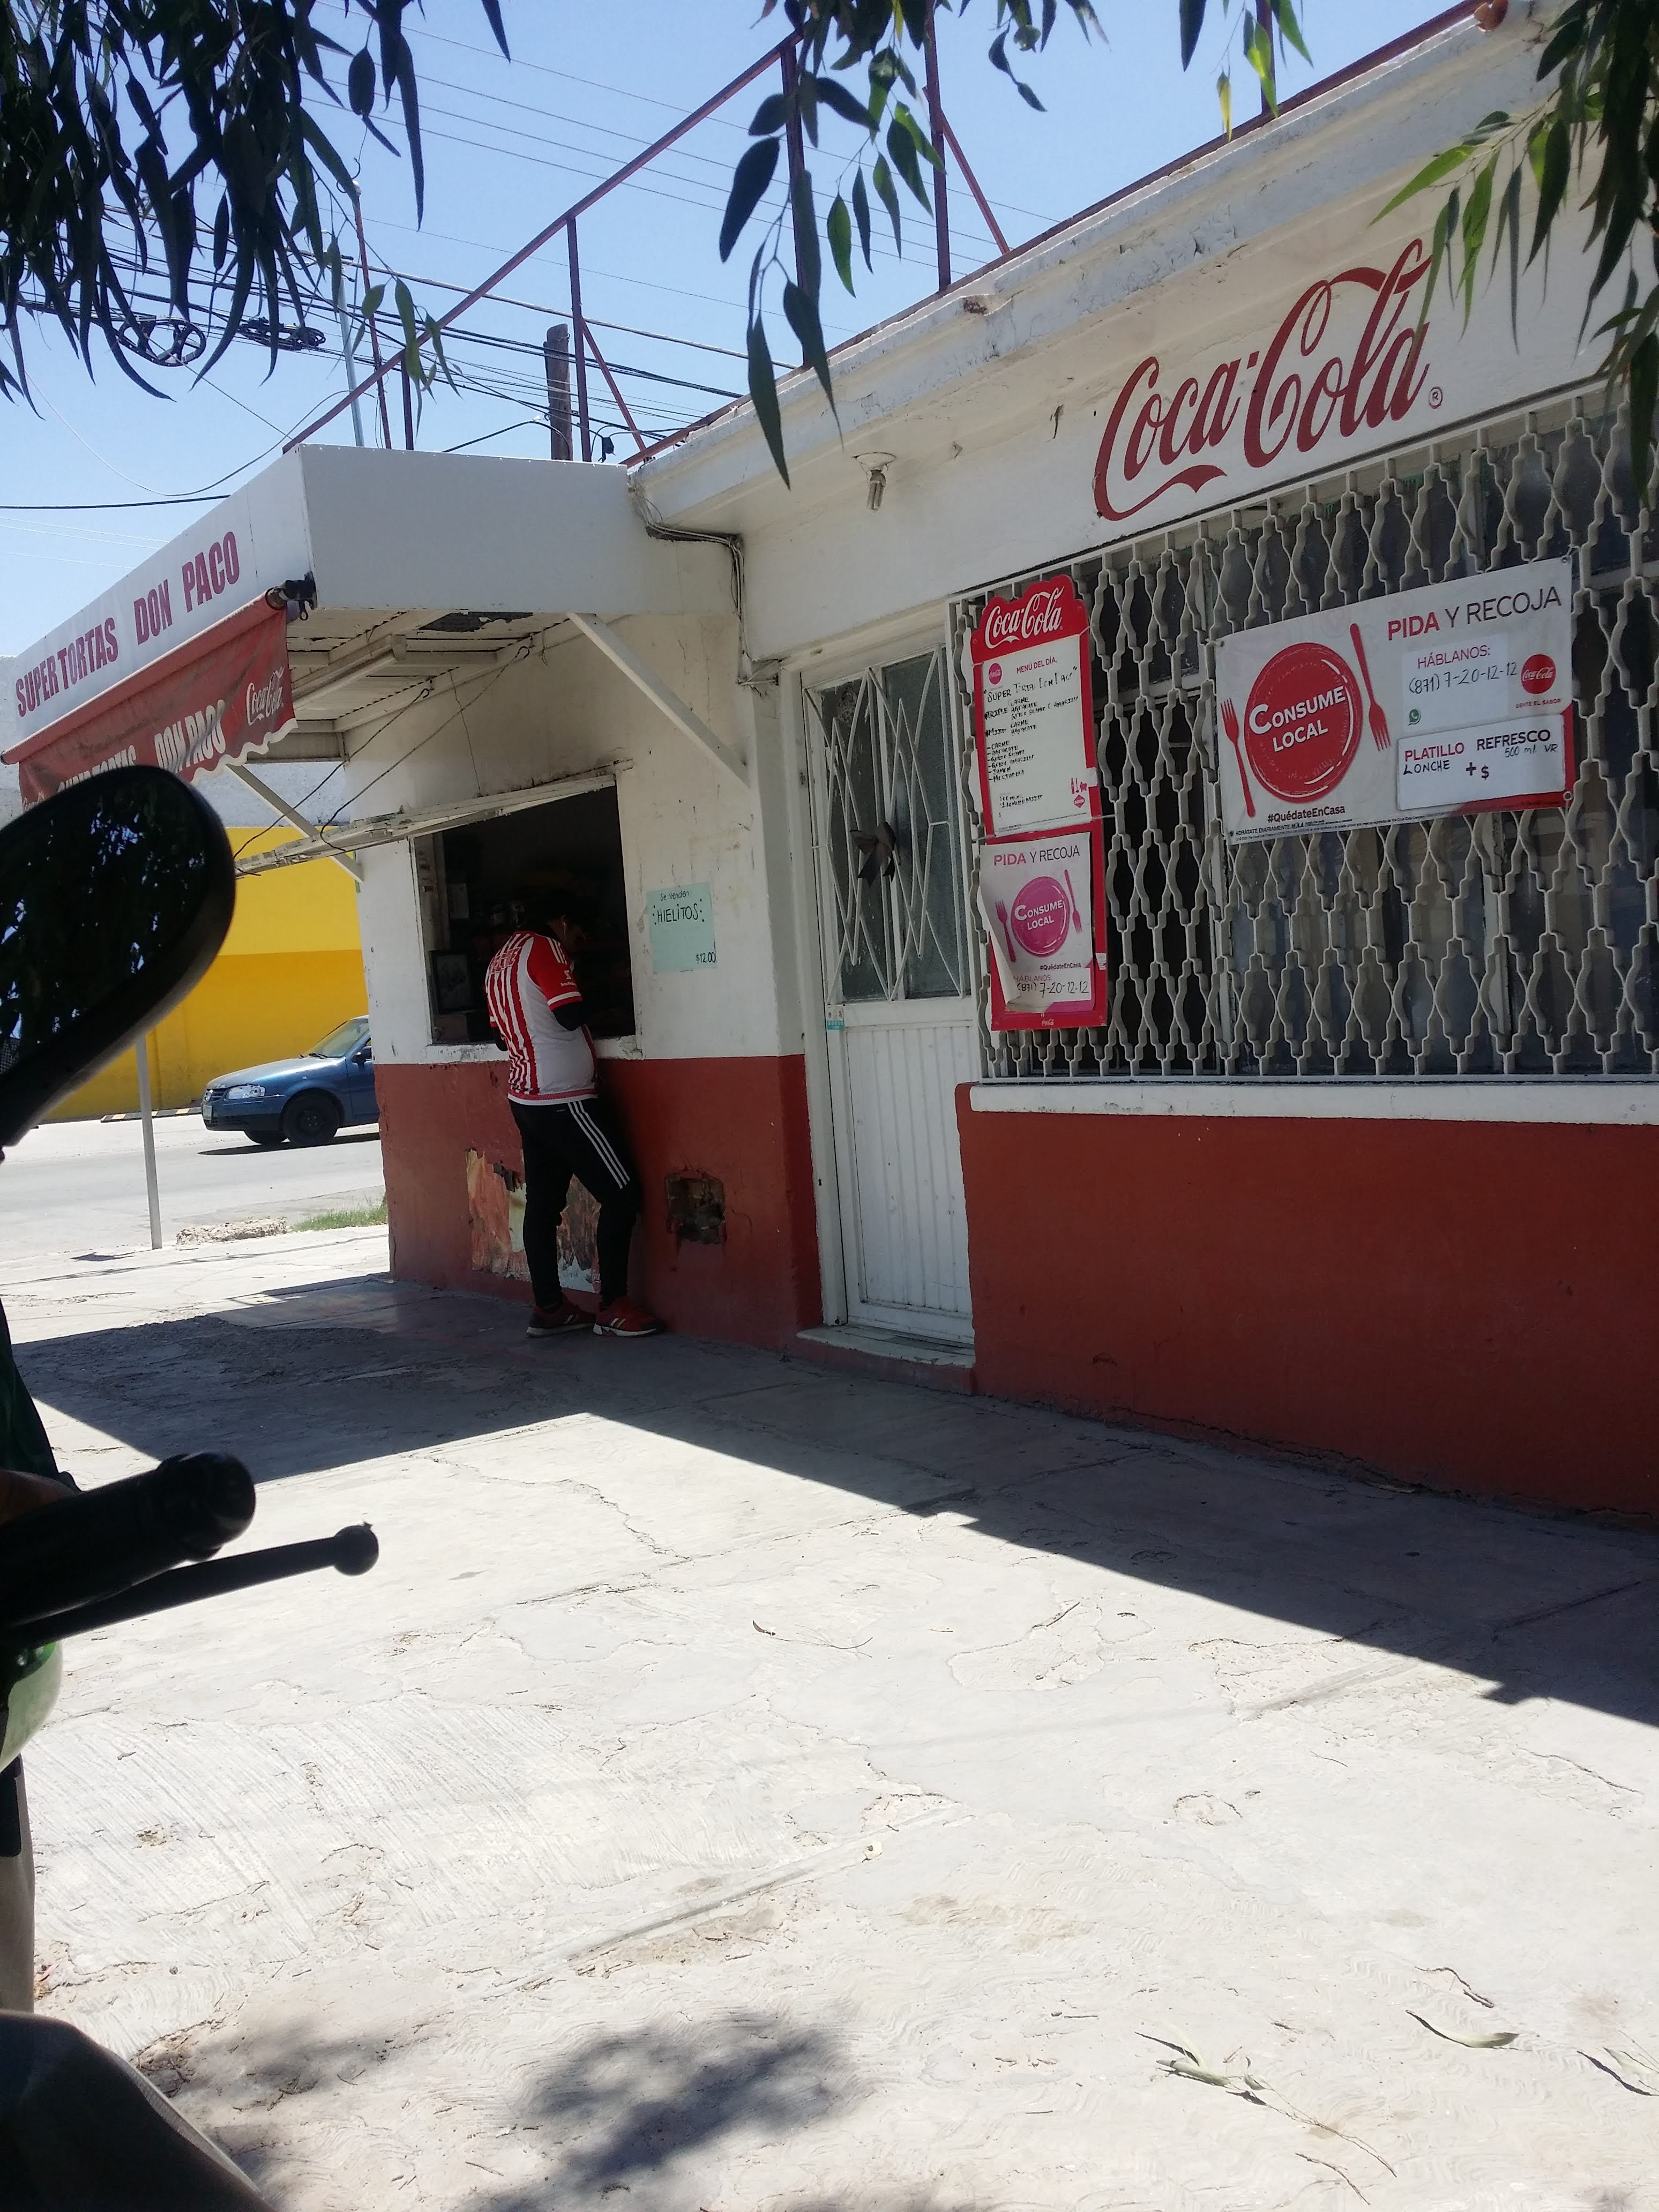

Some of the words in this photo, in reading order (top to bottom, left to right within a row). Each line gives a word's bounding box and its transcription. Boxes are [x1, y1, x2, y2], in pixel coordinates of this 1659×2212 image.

[1094, 238, 1432, 521] Coca-Cola
[985, 585, 1064, 648] Coca-Cola
[1388, 611, 1440, 641] PIDA
[1444, 606, 1460, 628] Y
[1467, 586, 1561, 624] RECOJA
[16, 655, 59, 717] SUPER
[57, 617, 118, 690] TORTAS
[133, 579, 173, 645] DON
[182, 532, 240, 612] PACO
[1017, 662, 1032, 674] MENÚ
[1034, 660, 1044, 669] DEL
[1417, 645, 1490, 669] HÁBLANOS:
[1409, 673, 1440, 694] (871)
[1444, 662, 1518, 687] 7-20-12-12
[1522, 667, 1556, 682] Coca-Cola
[1249, 686, 1346, 734] CONSUME
[1273, 723, 1328, 753] LOCAL
[1404, 742, 1464, 761] PLATILLO
[1477, 729, 1551, 751] REFRESCO
[1505, 746, 1520, 758] 500
[1403, 760, 1450, 775] LONCHE
[1481, 765, 1489, 780] $
[1268, 805, 1346, 823] #QuédateEnCasa
[993, 853, 1027, 866] PIDA
[1029, 851, 1038, 864] Y
[1040, 845, 1080, 862] RECOJA
[660, 893, 667, 901] Se
[1014, 900, 1064, 921] CONSUME
[1027, 917, 1054, 931] LOCAL
[1017, 982, 1037, 991] (871)
[1039, 981, 1089, 998] 7-20-12-12
